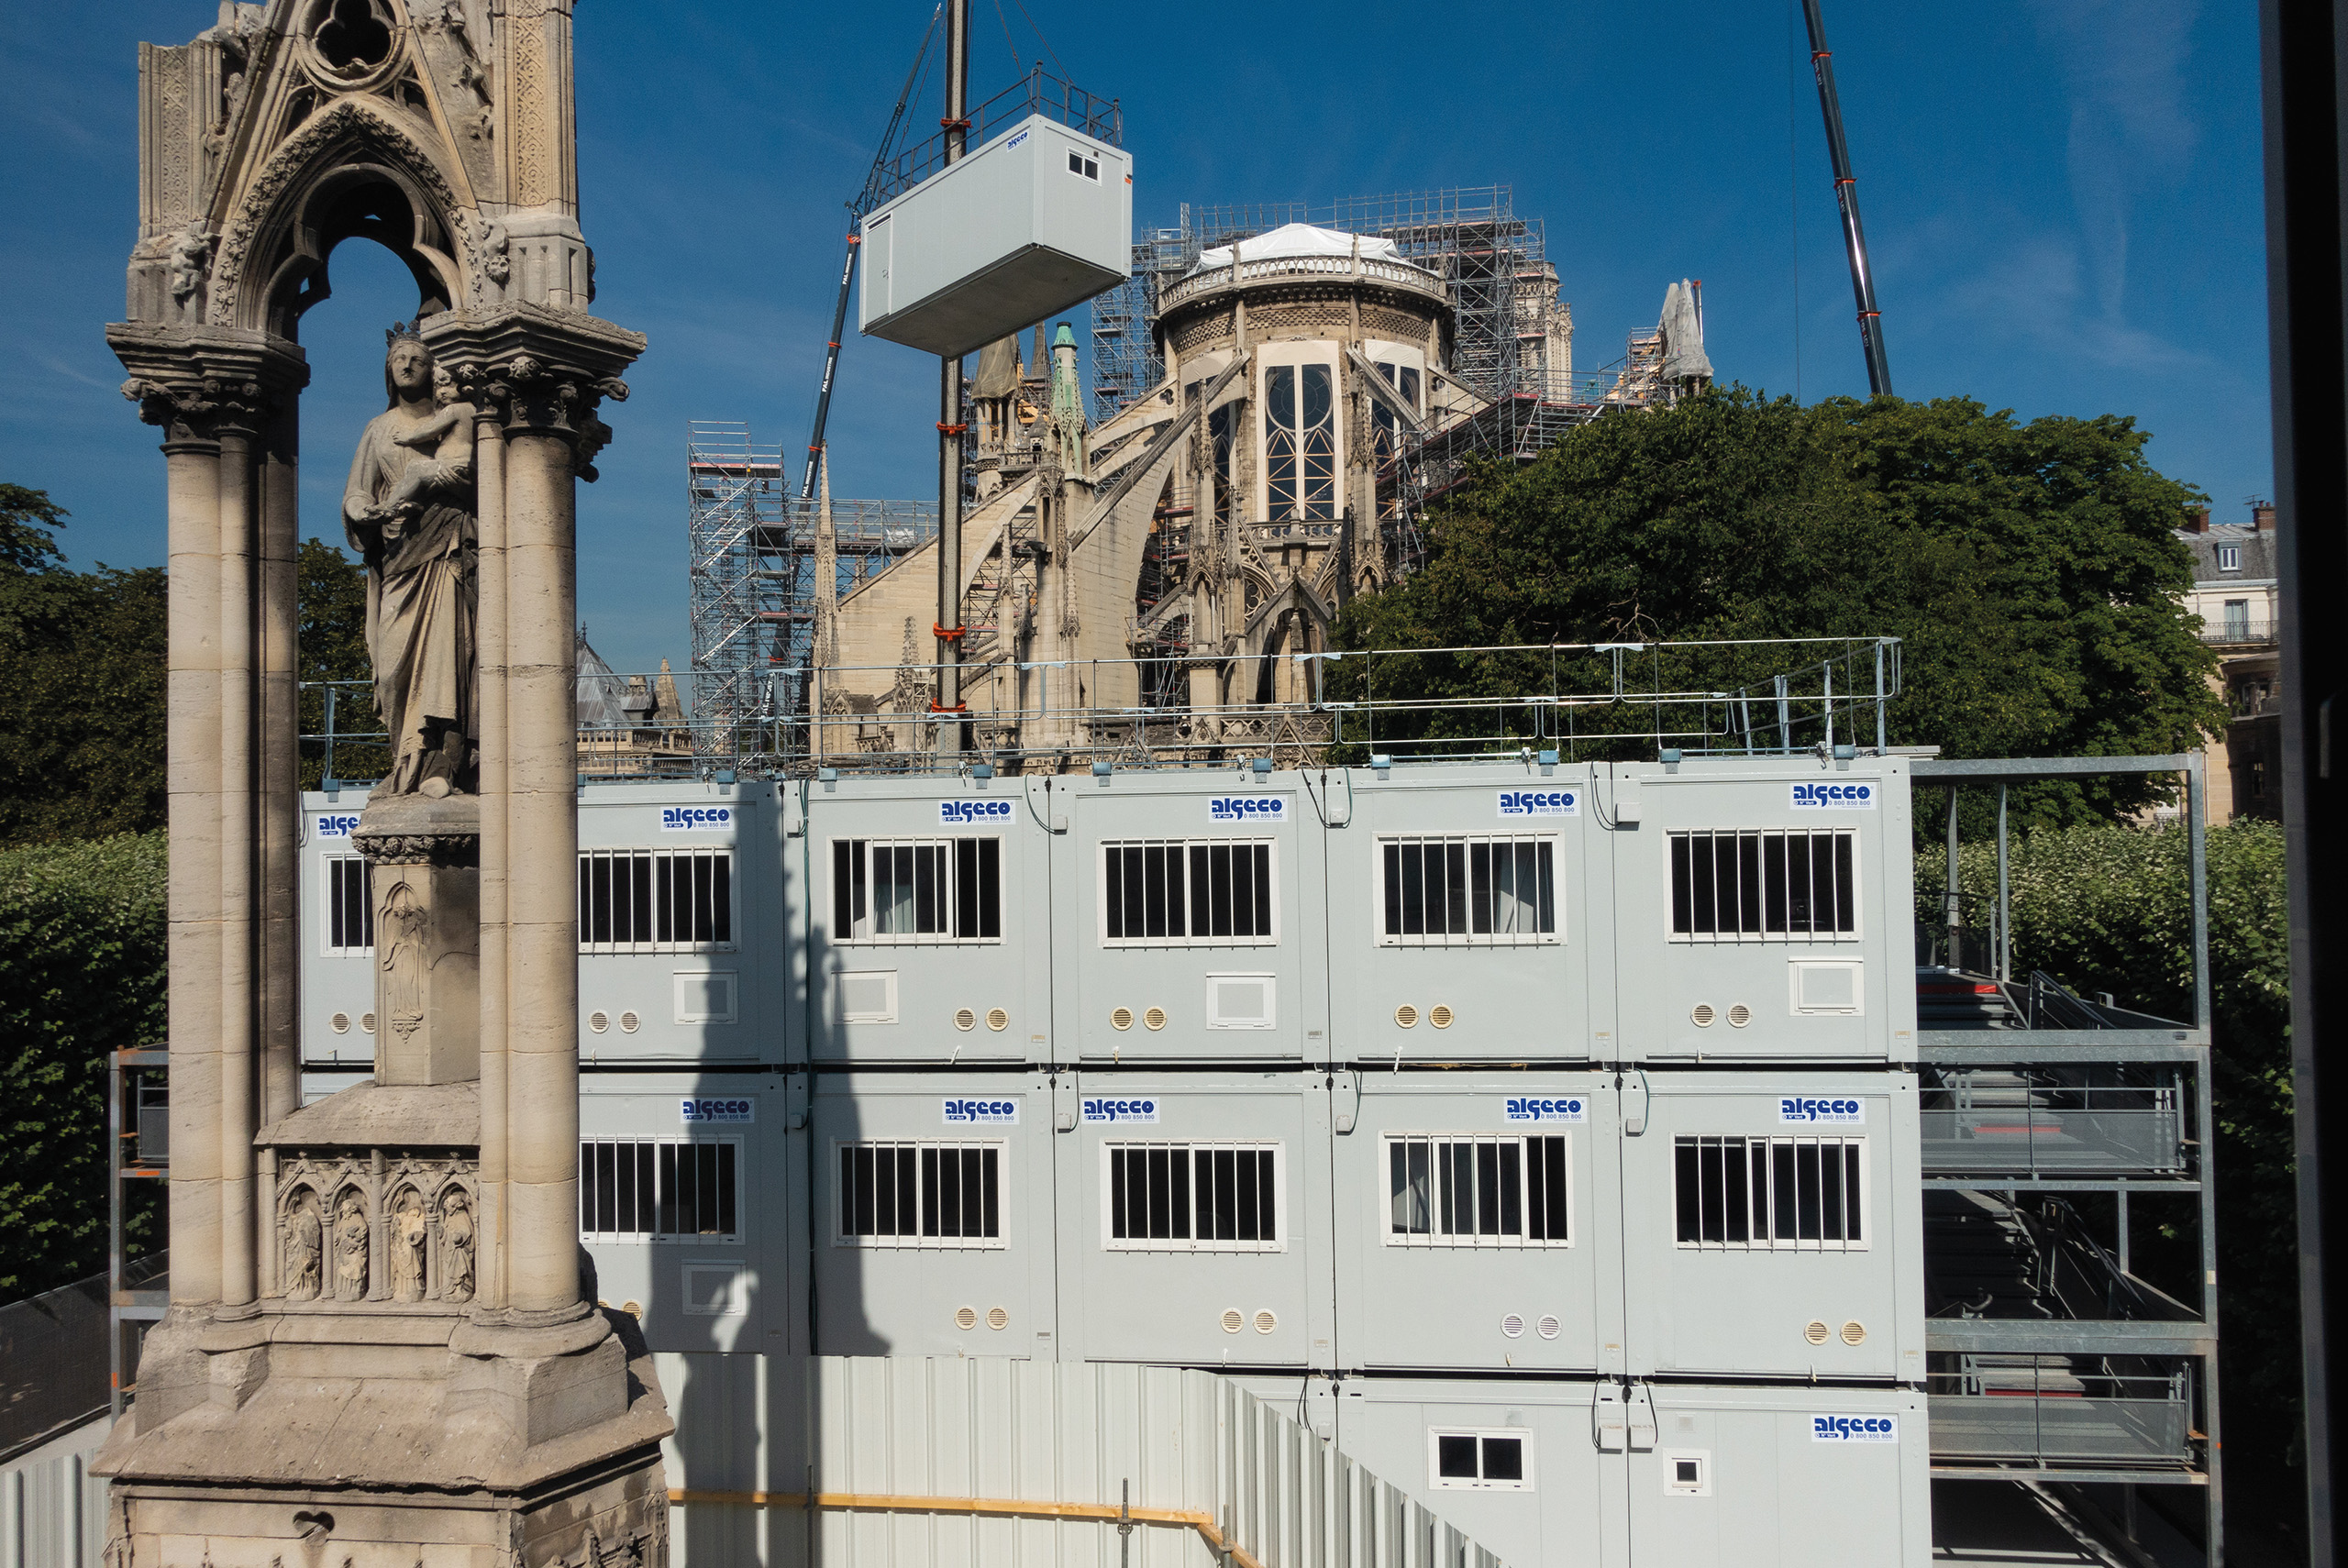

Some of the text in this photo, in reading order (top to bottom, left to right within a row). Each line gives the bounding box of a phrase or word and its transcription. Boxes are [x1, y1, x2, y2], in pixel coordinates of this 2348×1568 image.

[1501, 792, 1574, 814] algeco
[1794, 783, 1870, 807] algeco
[664, 807, 729, 829] algeco
[942, 801, 1010, 822] algeco
[1212, 798, 1282, 820] algeco
[319, 815, 360, 836] alge
[683, 1099, 749, 1121] algeco
[946, 1099, 1013, 1121] algeco
[1084, 1099, 1154, 1121] algeco
[1507, 1098, 1581, 1121] algeco
[1782, 1098, 1858, 1121] algeco
[1814, 1416, 1892, 1440] algeco
